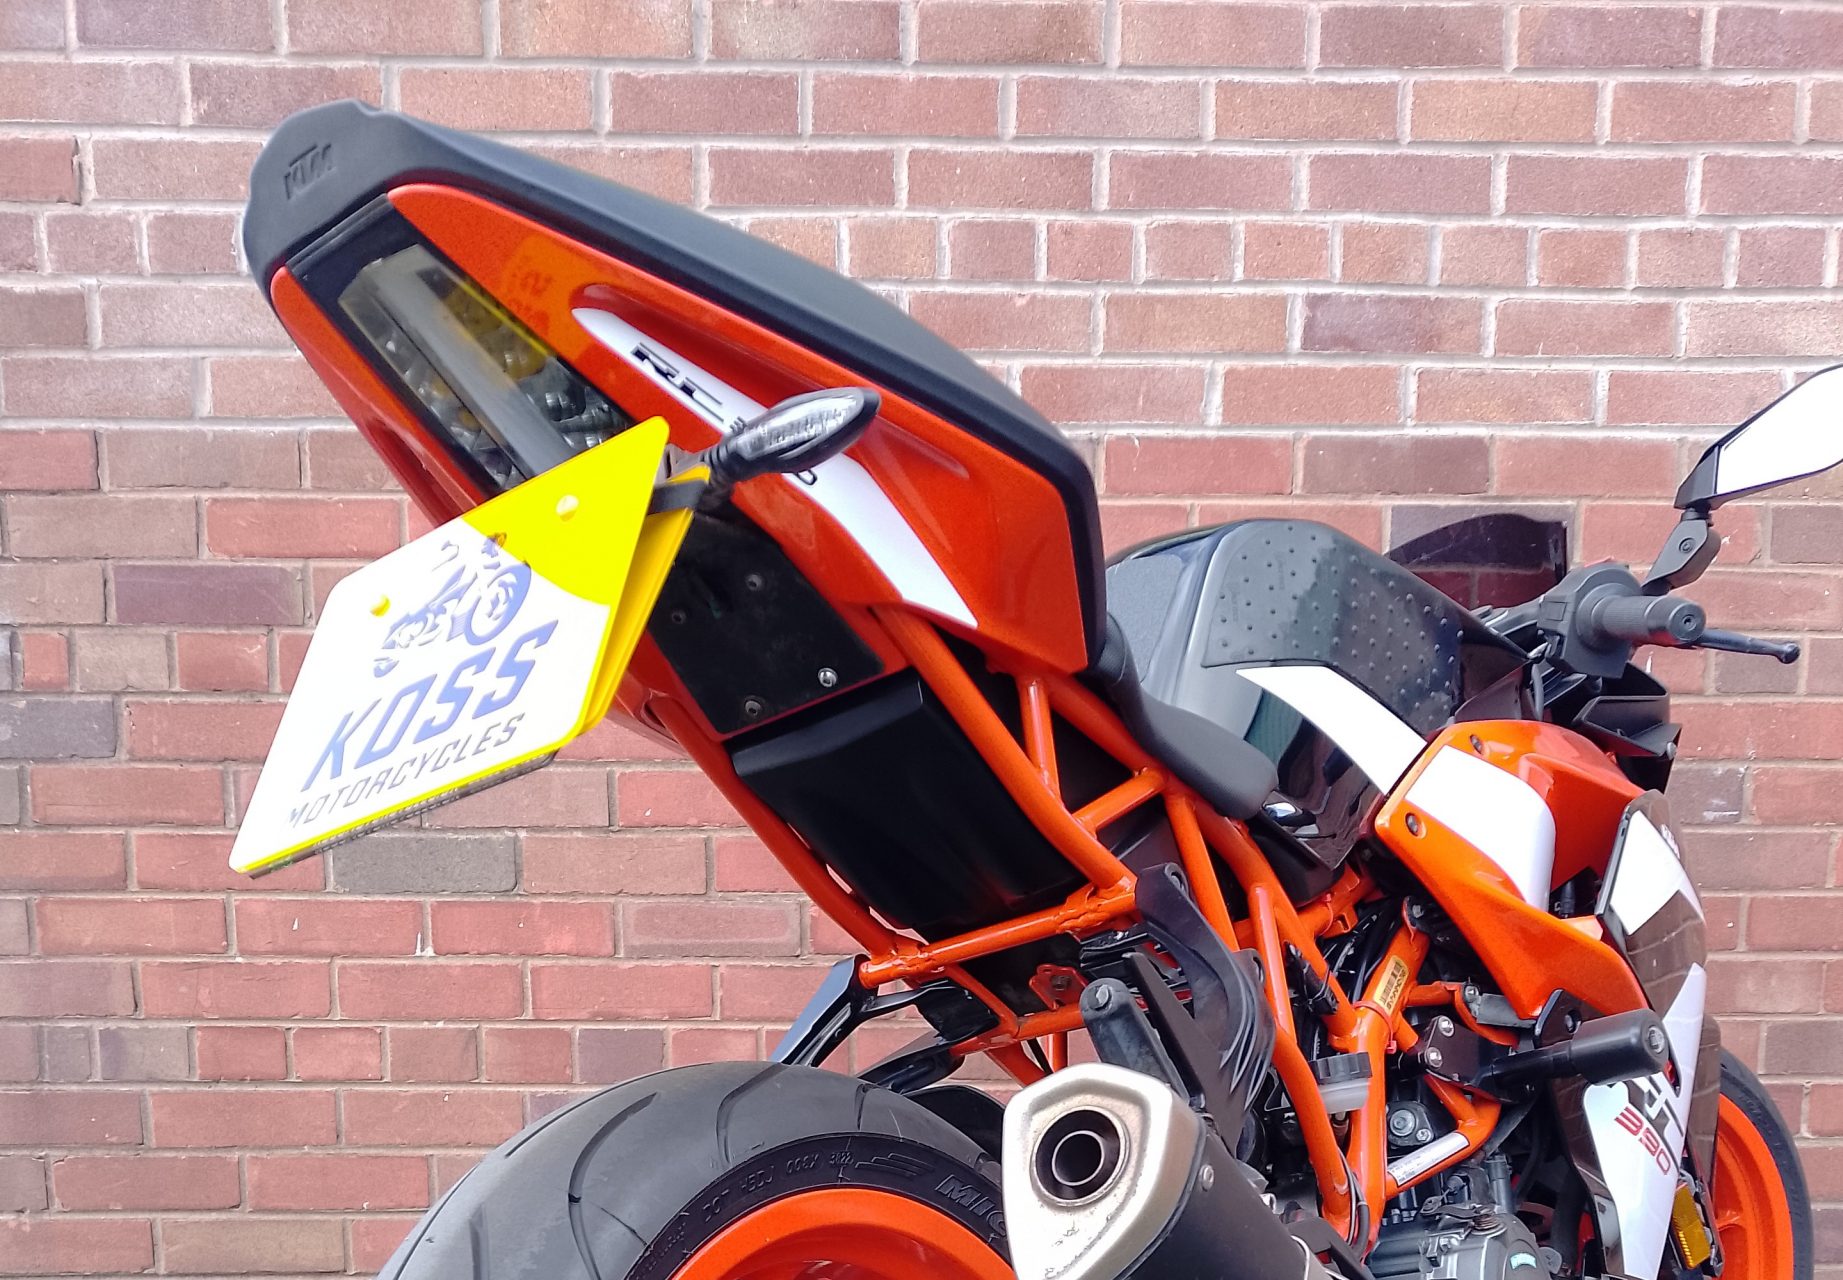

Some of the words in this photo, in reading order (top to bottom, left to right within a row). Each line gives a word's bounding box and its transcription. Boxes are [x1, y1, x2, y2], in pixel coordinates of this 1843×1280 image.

[300, 619, 559, 793] KOSS
[286, 712, 526, 830] MOTORCYCLES
[1613, 1106, 1671, 1175] 390
